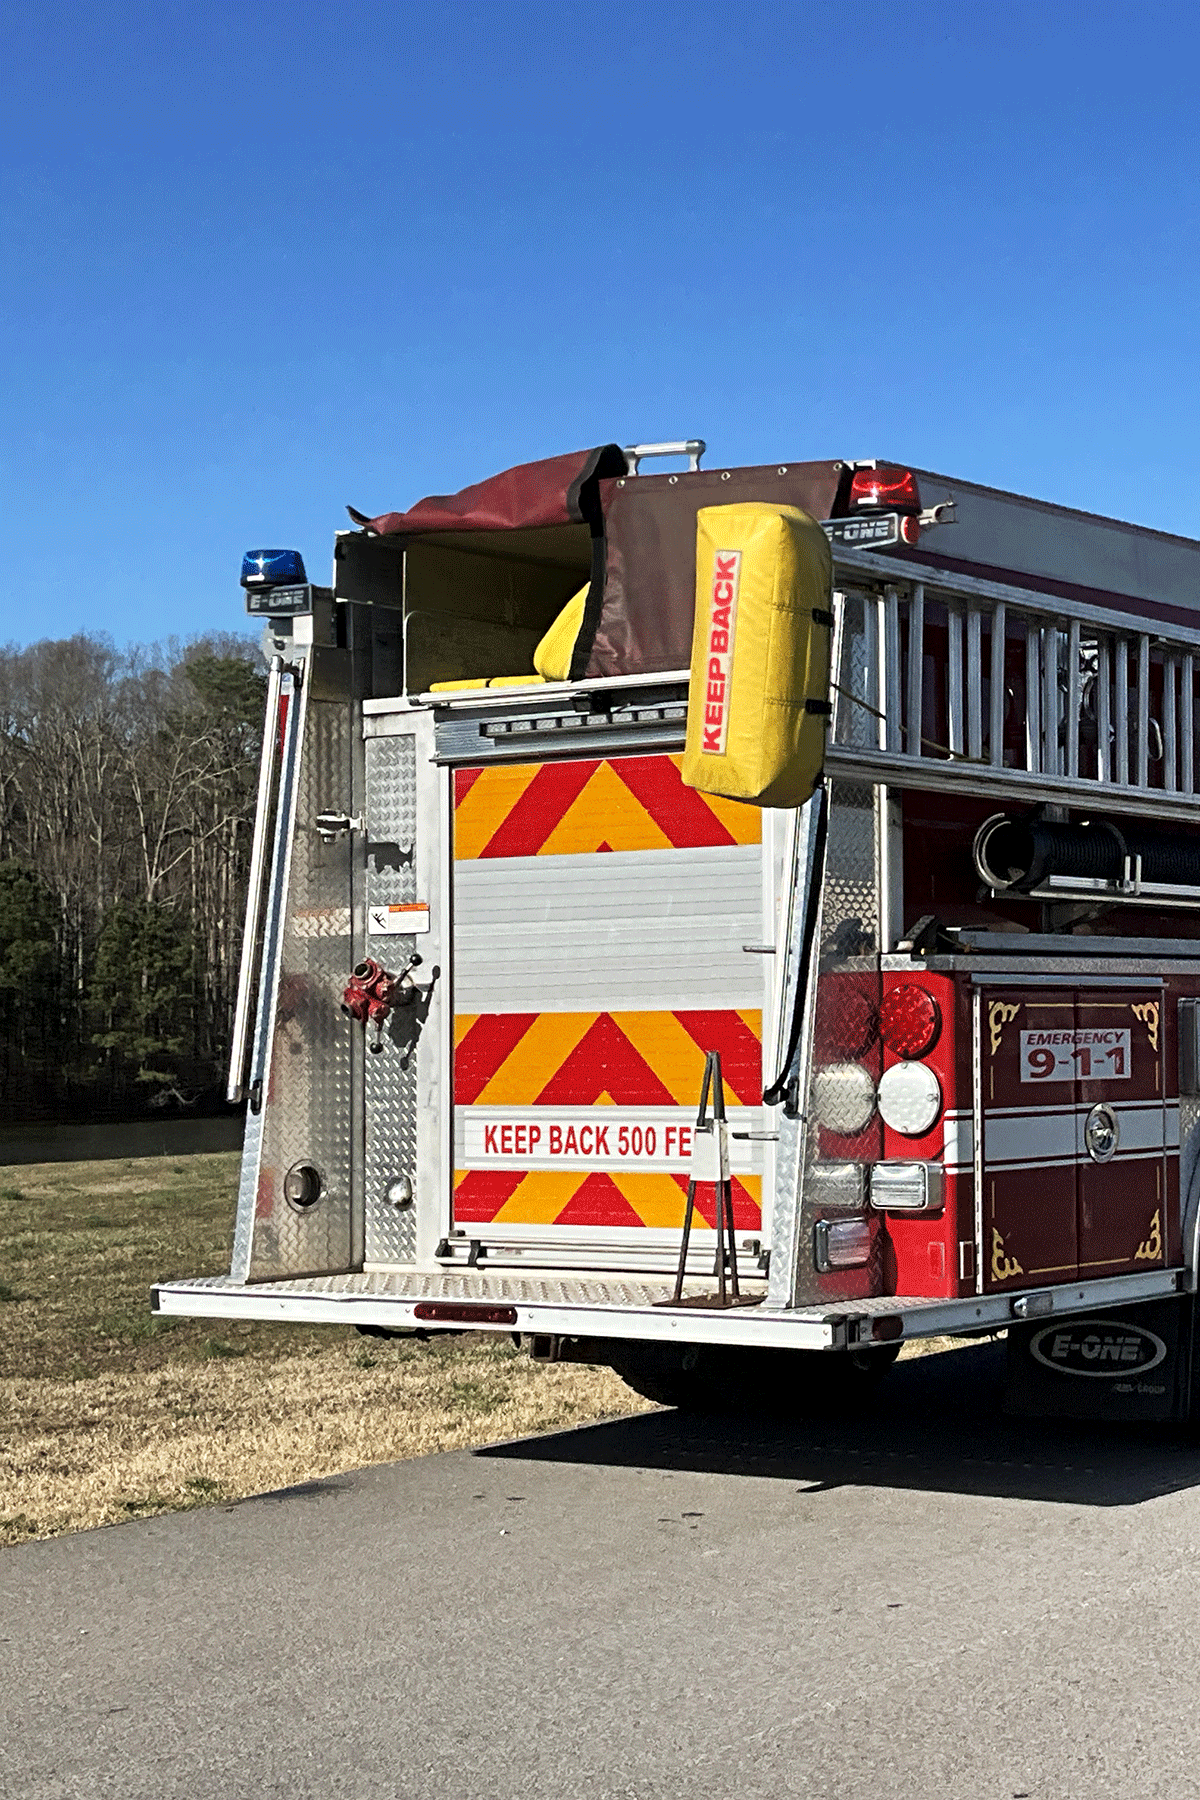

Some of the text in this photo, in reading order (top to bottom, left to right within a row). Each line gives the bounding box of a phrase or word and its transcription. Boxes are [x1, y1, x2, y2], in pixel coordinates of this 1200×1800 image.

[703, 556, 737, 752] KEEP BACK
[1027, 1031, 1125, 1045] EMERGENCY
[1028, 1047, 1125, 1078] 9-1-1
[484, 1125, 696, 1157] KEEP BACK 500 FE
[1051, 1335, 1142, 1361] E-ONE
